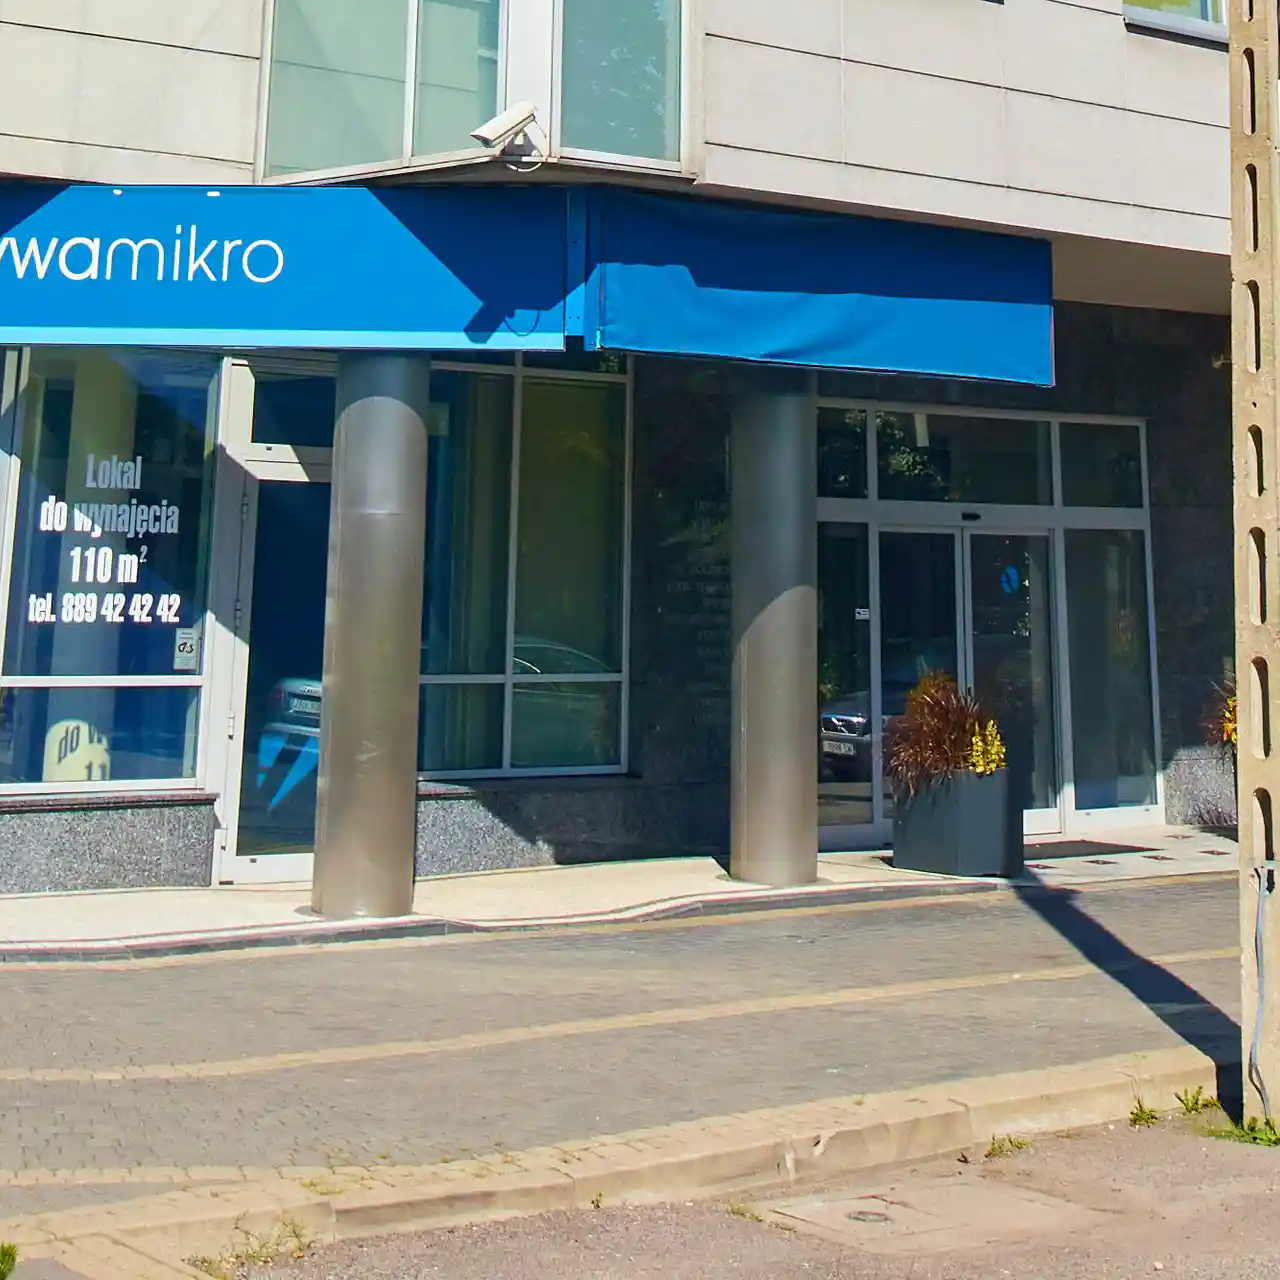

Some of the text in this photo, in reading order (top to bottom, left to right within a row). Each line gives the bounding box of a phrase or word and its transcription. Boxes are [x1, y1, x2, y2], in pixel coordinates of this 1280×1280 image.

[85, 453, 142, 489] Lokal
[40, 495, 179, 538] do wynajęcia
[70, 545, 147, 583] 110 m²
[28, 592, 180, 623] tel. 889 42 42 42
